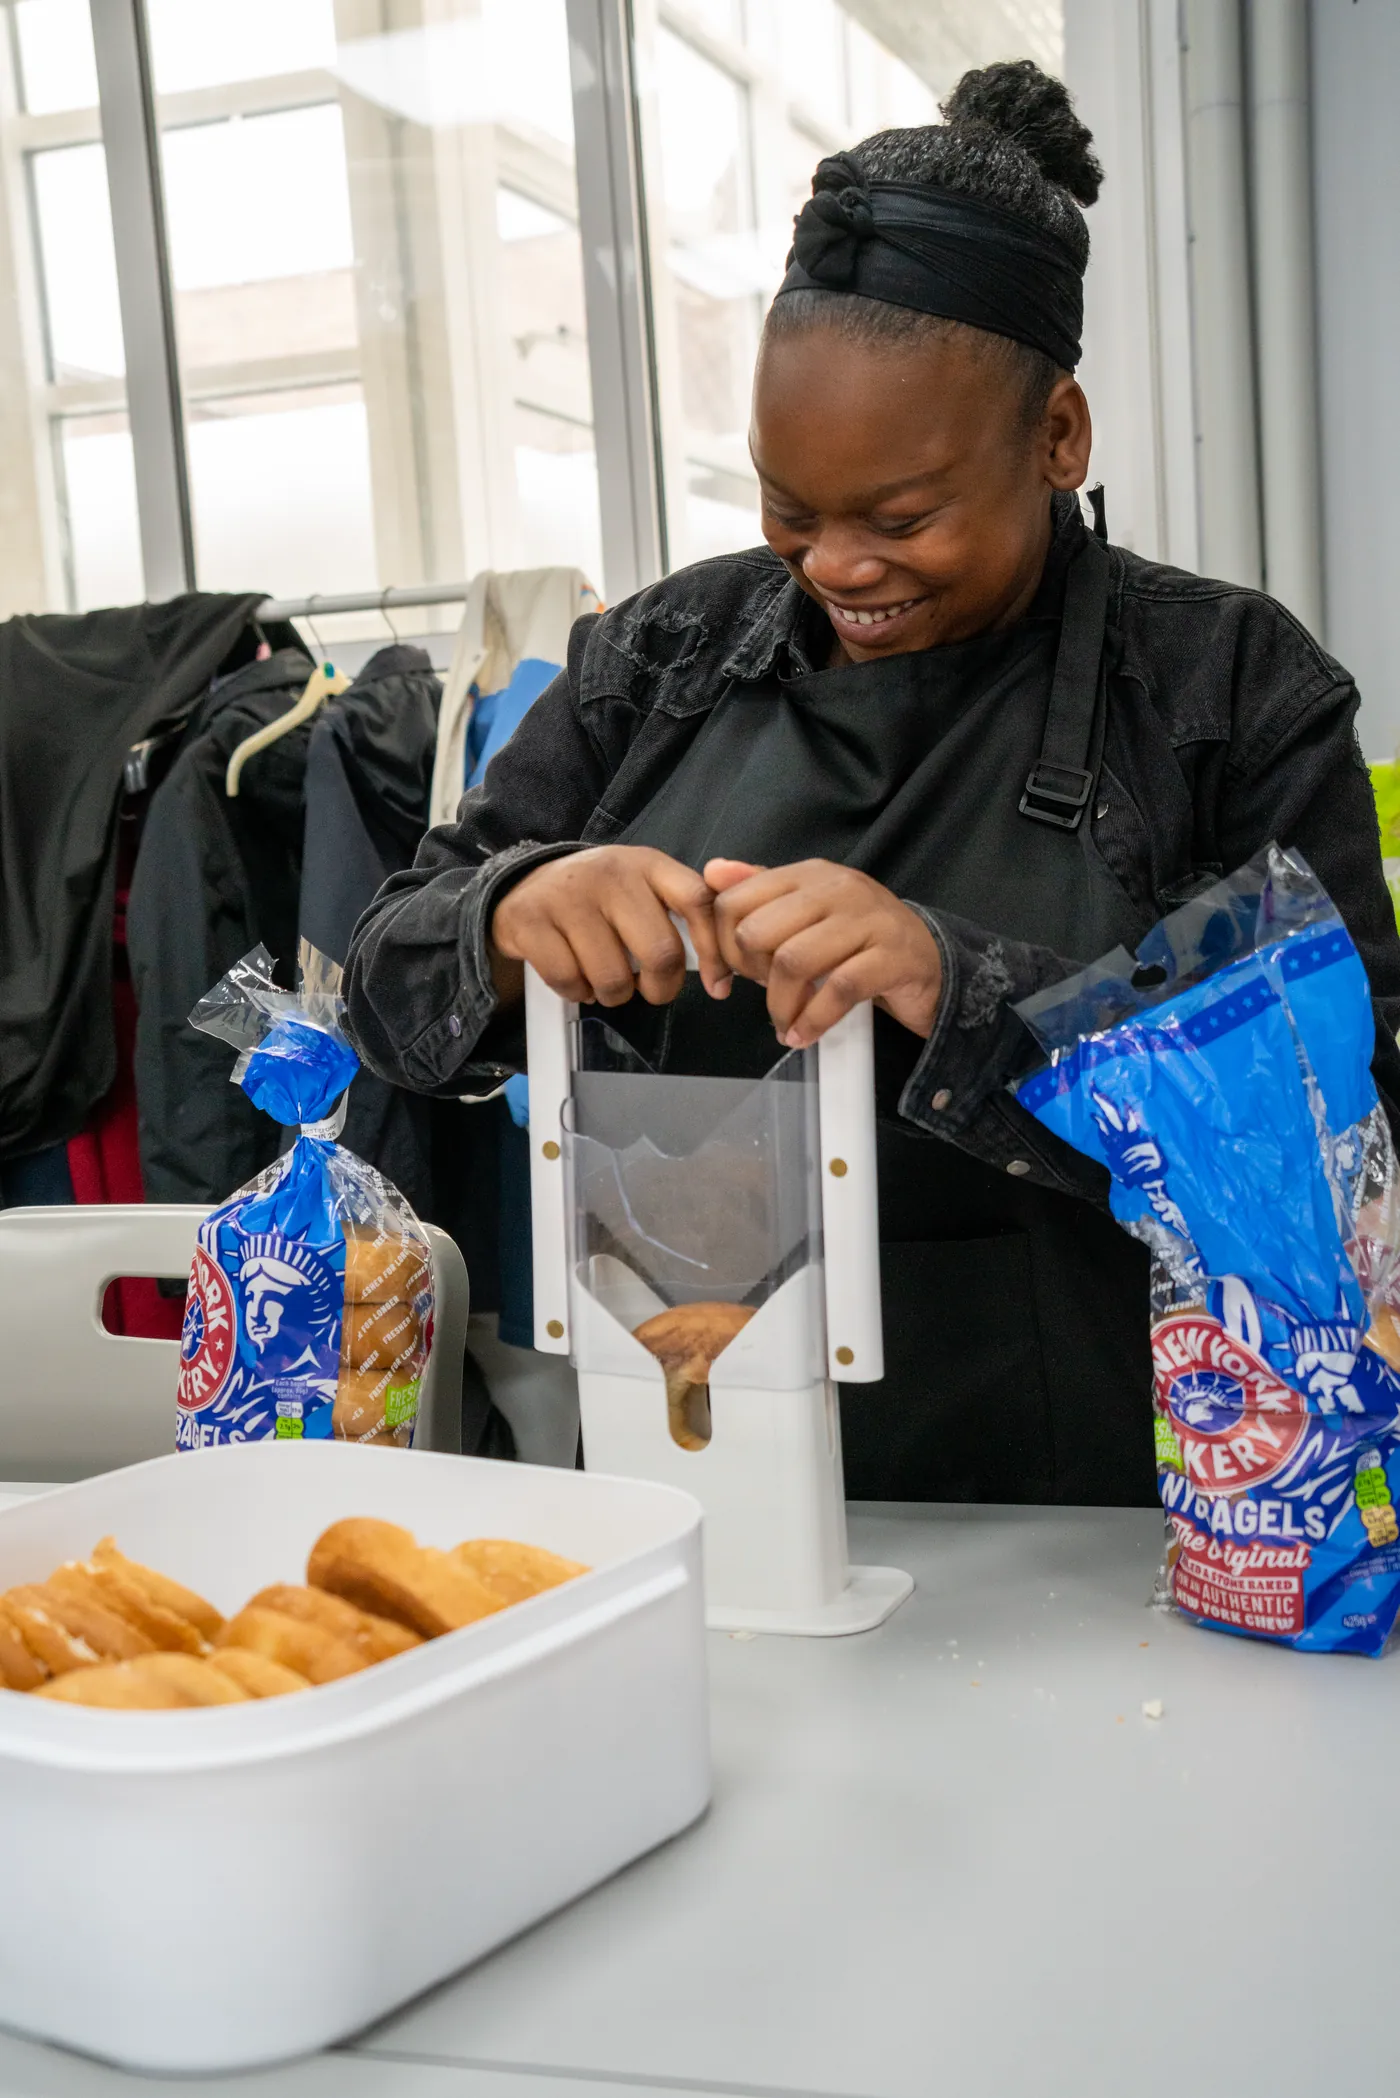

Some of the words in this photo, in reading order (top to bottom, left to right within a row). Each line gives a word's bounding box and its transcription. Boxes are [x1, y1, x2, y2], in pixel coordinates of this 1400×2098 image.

[372, 1295, 400, 1321] LONGER
[382, 1316, 411, 1345] FRESHER
[356, 1349, 380, 1377] LONGER
[1152, 1327, 1210, 1385] NEW
[368, 1371, 393, 1401] FRESHER
[1183, 1413, 1282, 1480] KERY
[1161, 1471, 1196, 1514] NY
[1171, 1516, 1208, 1551] The
[1212, 1571, 1246, 1590] STONE
[1249, 1579, 1294, 1591] BAKED
[1176, 1587, 1199, 1610] NEW
[1202, 1602, 1242, 1624] YORK
[1244, 1613, 1296, 1631] CHEW
[1201, 1583, 1295, 1615] AUTHENTIC
